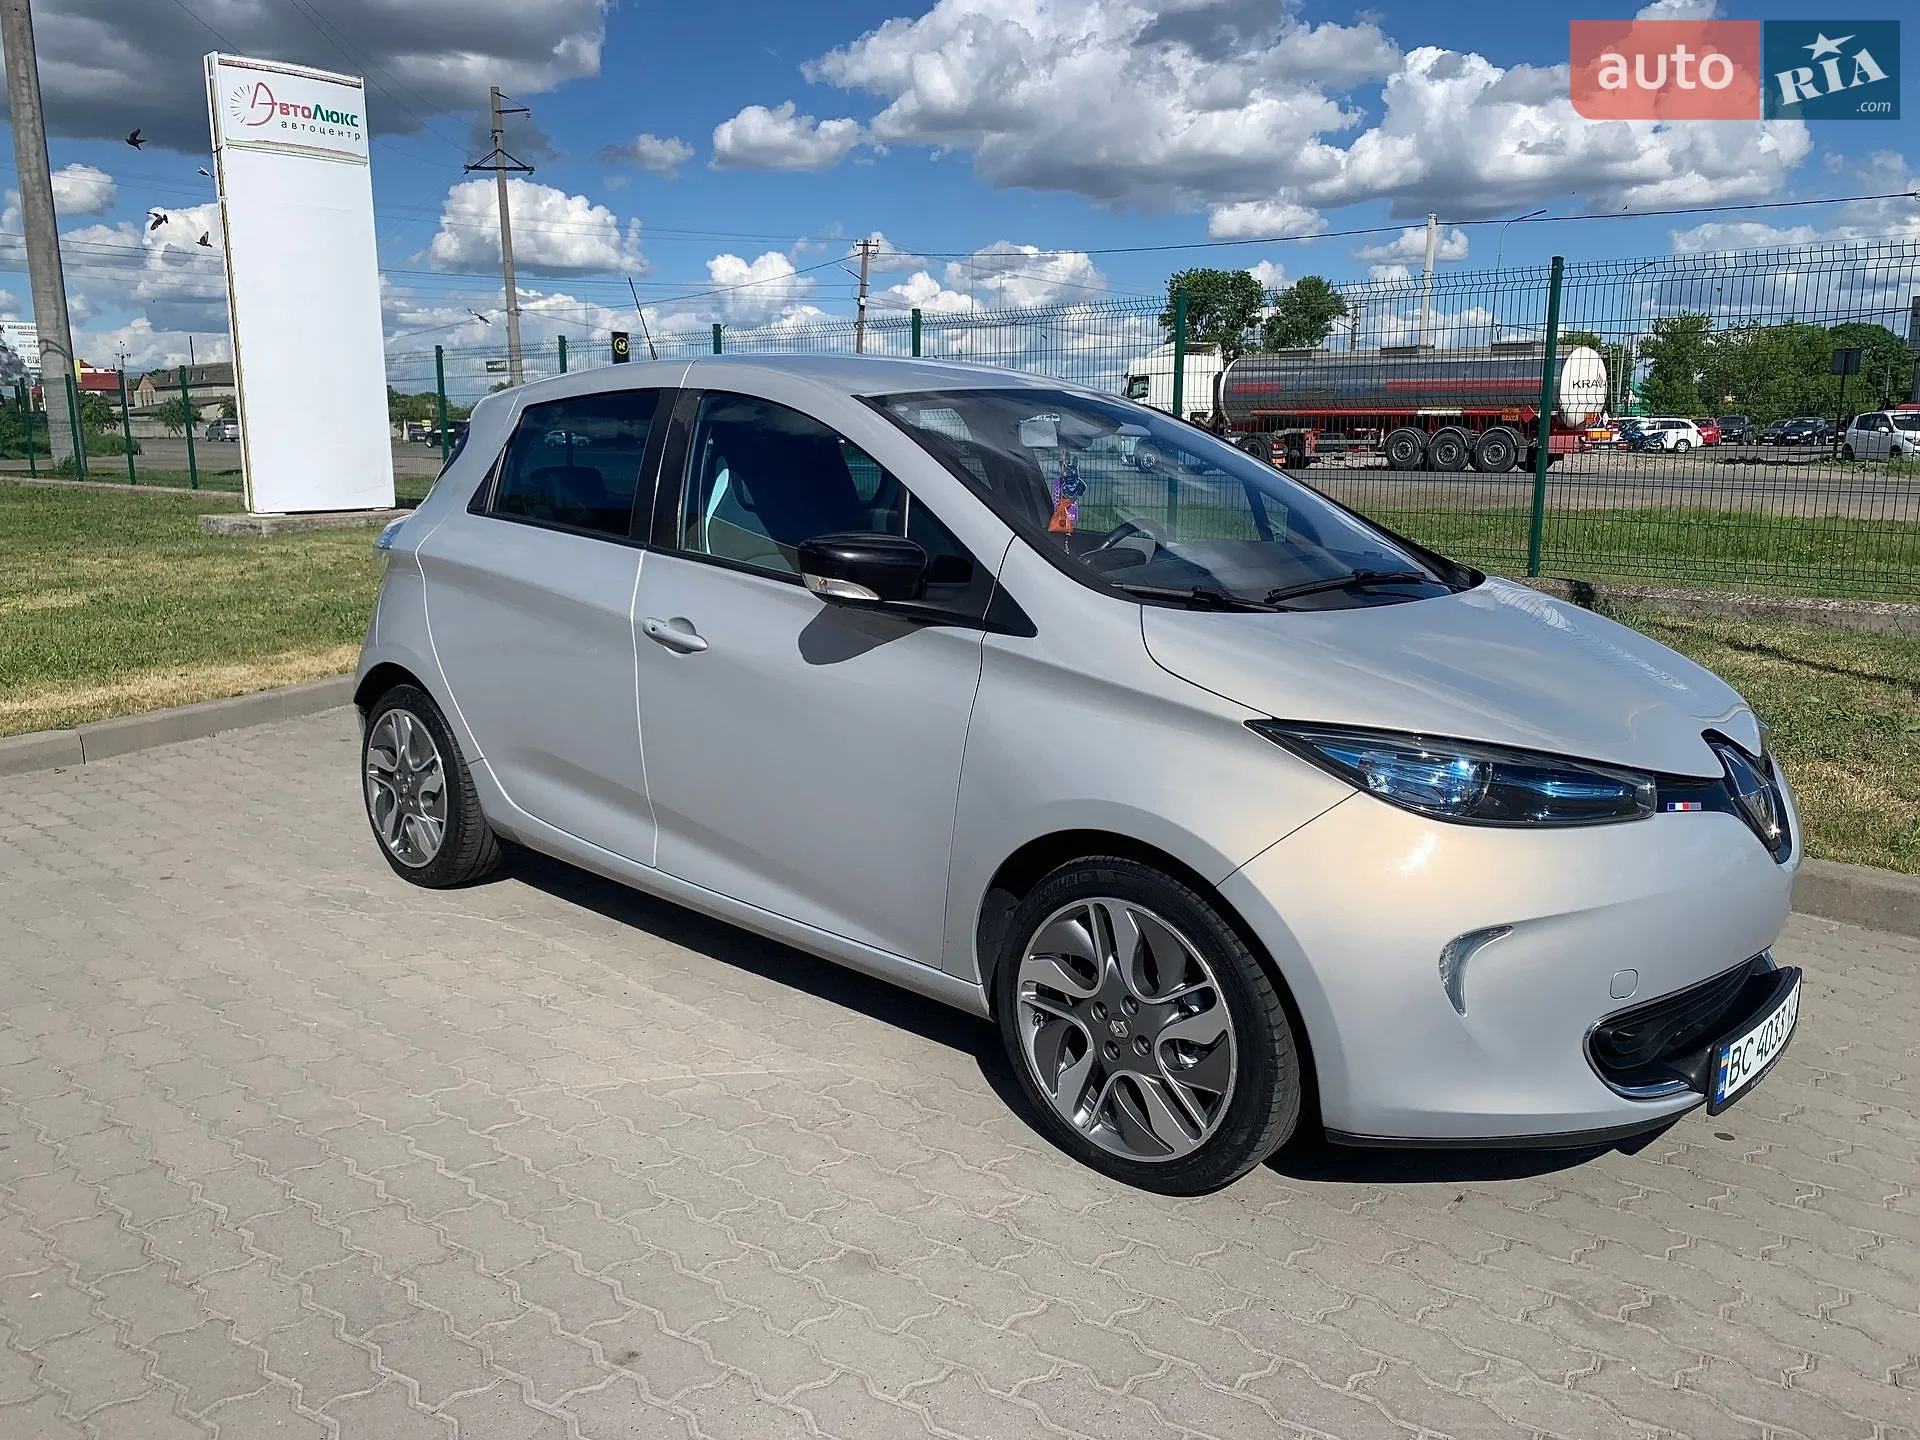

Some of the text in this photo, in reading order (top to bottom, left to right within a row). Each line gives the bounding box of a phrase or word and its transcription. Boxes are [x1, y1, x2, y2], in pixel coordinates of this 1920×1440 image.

[281, 120, 361, 141] автоцентр
[1729, 1037, 1754, 1087] BC
[1756, 1004, 1786, 1062] 4033
